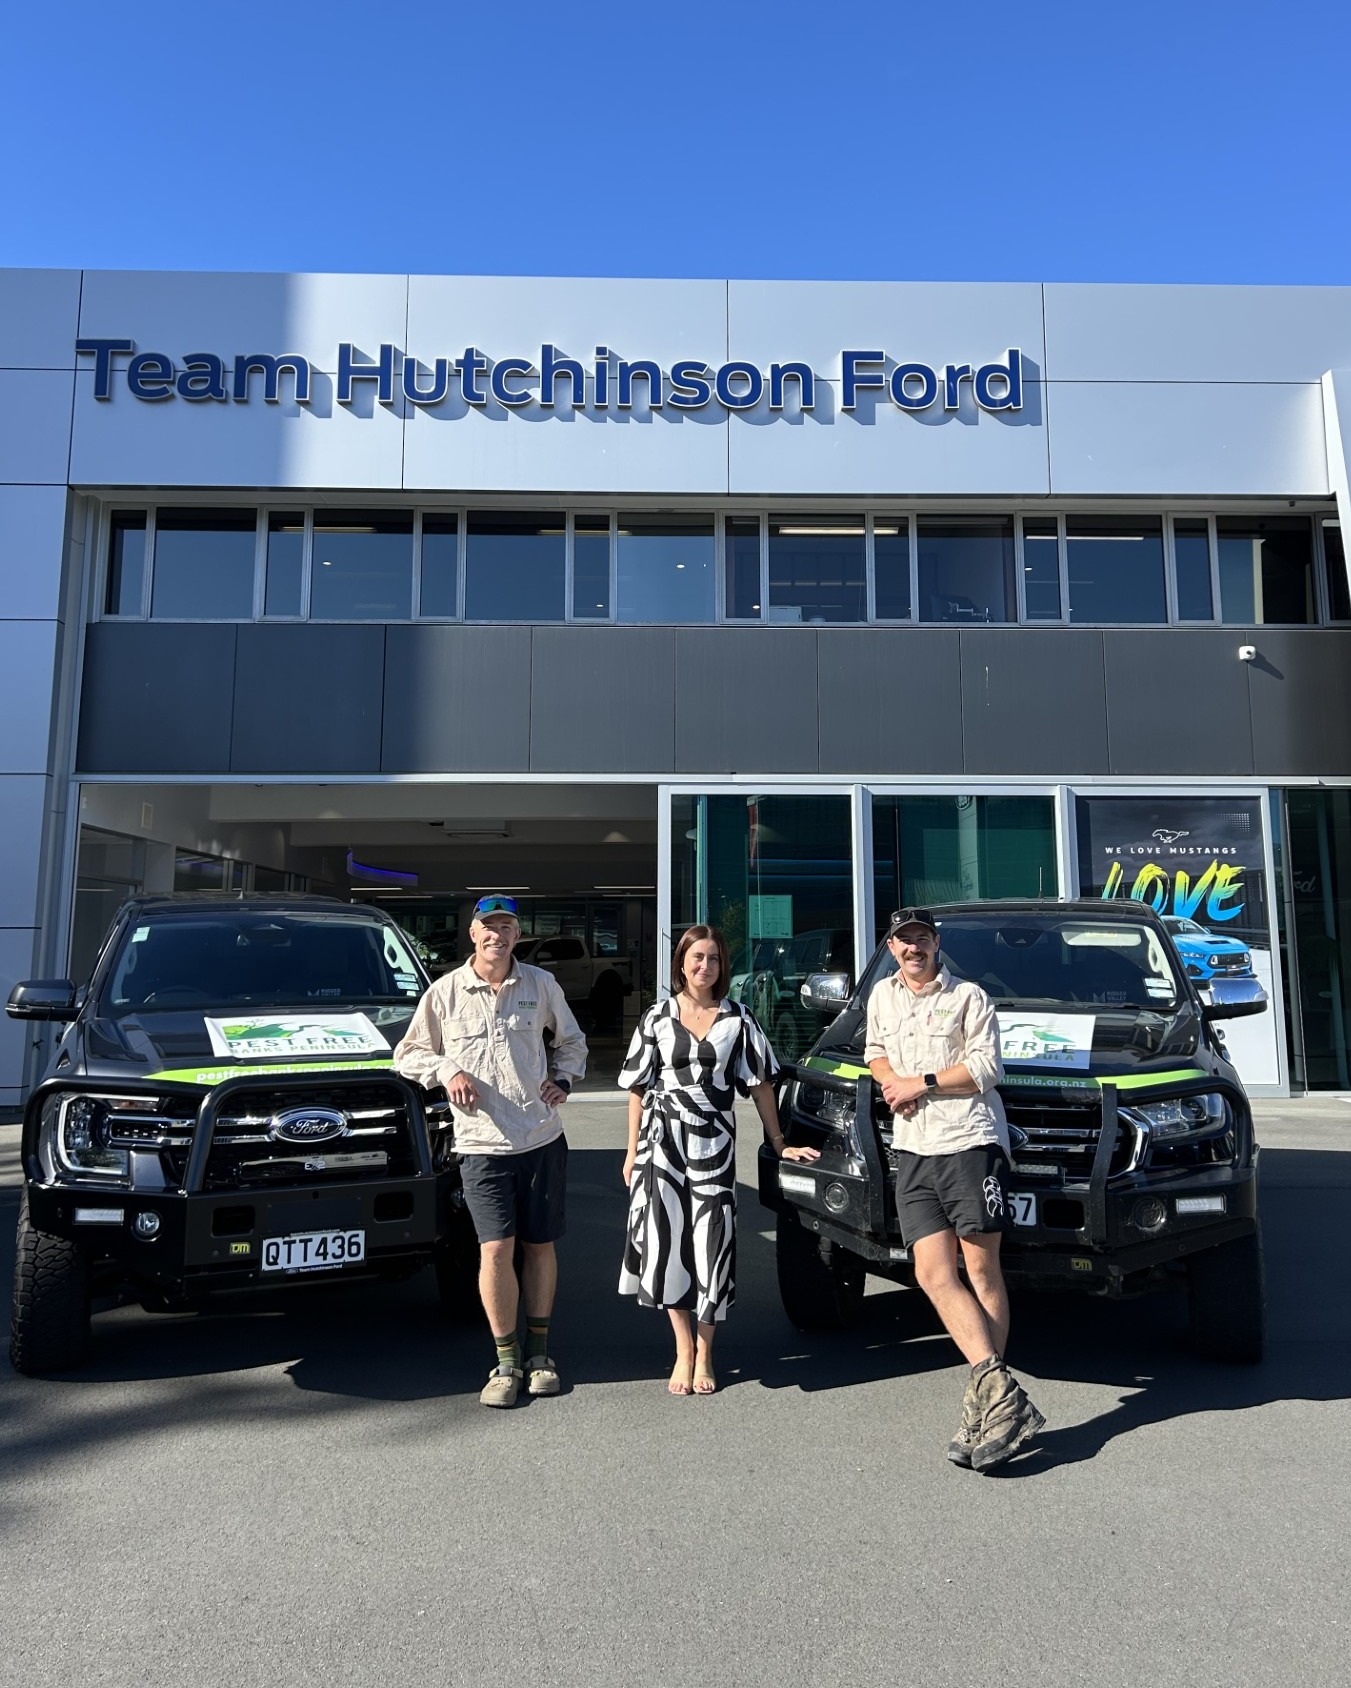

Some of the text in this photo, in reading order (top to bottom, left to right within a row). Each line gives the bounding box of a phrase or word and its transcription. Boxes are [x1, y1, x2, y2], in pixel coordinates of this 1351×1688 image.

[76, 338, 1024, 411] Team Hutchinson Ford
[1104, 846, 1238, 855] WE LOVE MUSTANGS
[229, 1035, 373, 1049] PEST FREE
[230, 1042, 376, 1055] BANKS PENINSULA
[1003, 1040, 1077, 1054] FREE
[1002, 1051, 1075, 1061] NINSULA
[1000, 1076, 1087, 1088] ninsula.org.nz
[291, 1118, 330, 1135] Ford
[265, 1234, 362, 1266] QTT436
